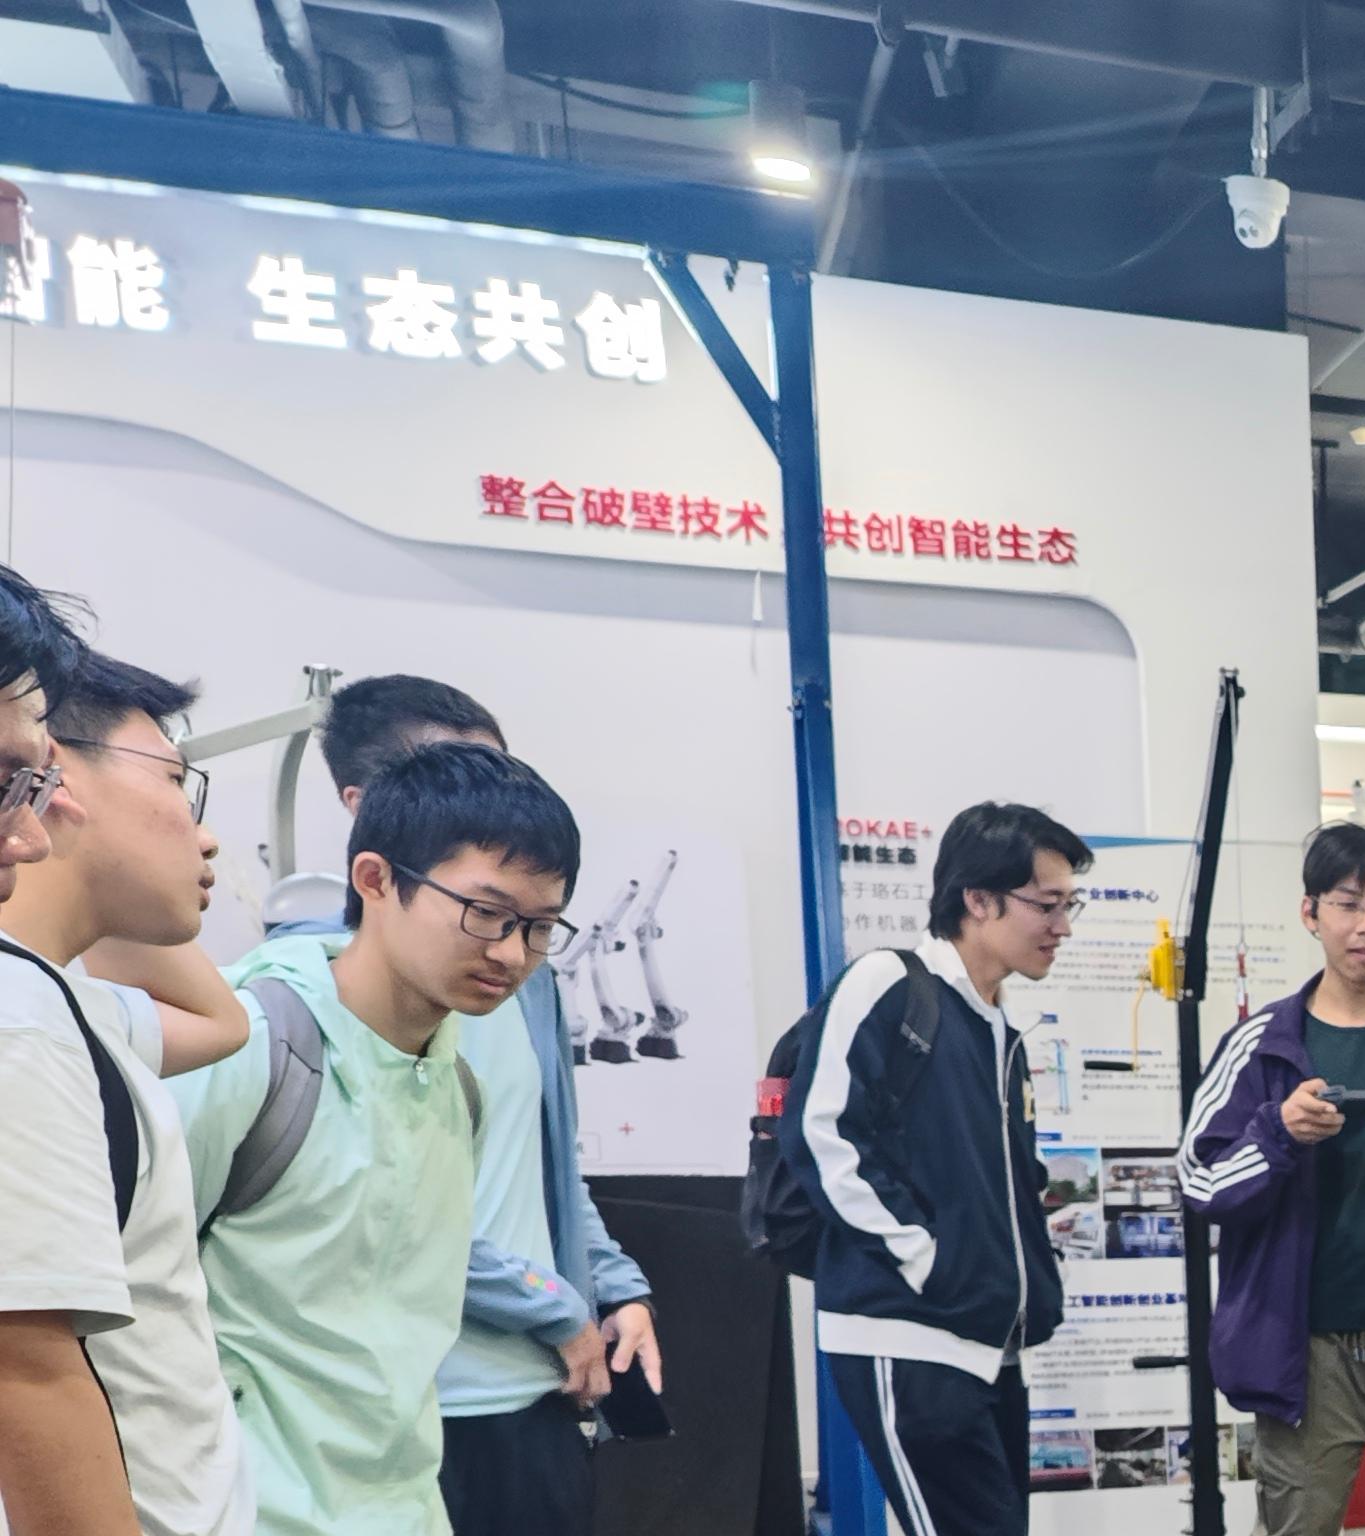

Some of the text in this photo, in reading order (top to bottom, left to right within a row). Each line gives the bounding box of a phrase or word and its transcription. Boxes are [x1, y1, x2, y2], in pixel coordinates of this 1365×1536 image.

[247, 254, 667, 383] 生态共创
[480, 474, 1079, 566] 整合破壁技术 共创智能生态
[839, 819, 932, 840] OKAE+
